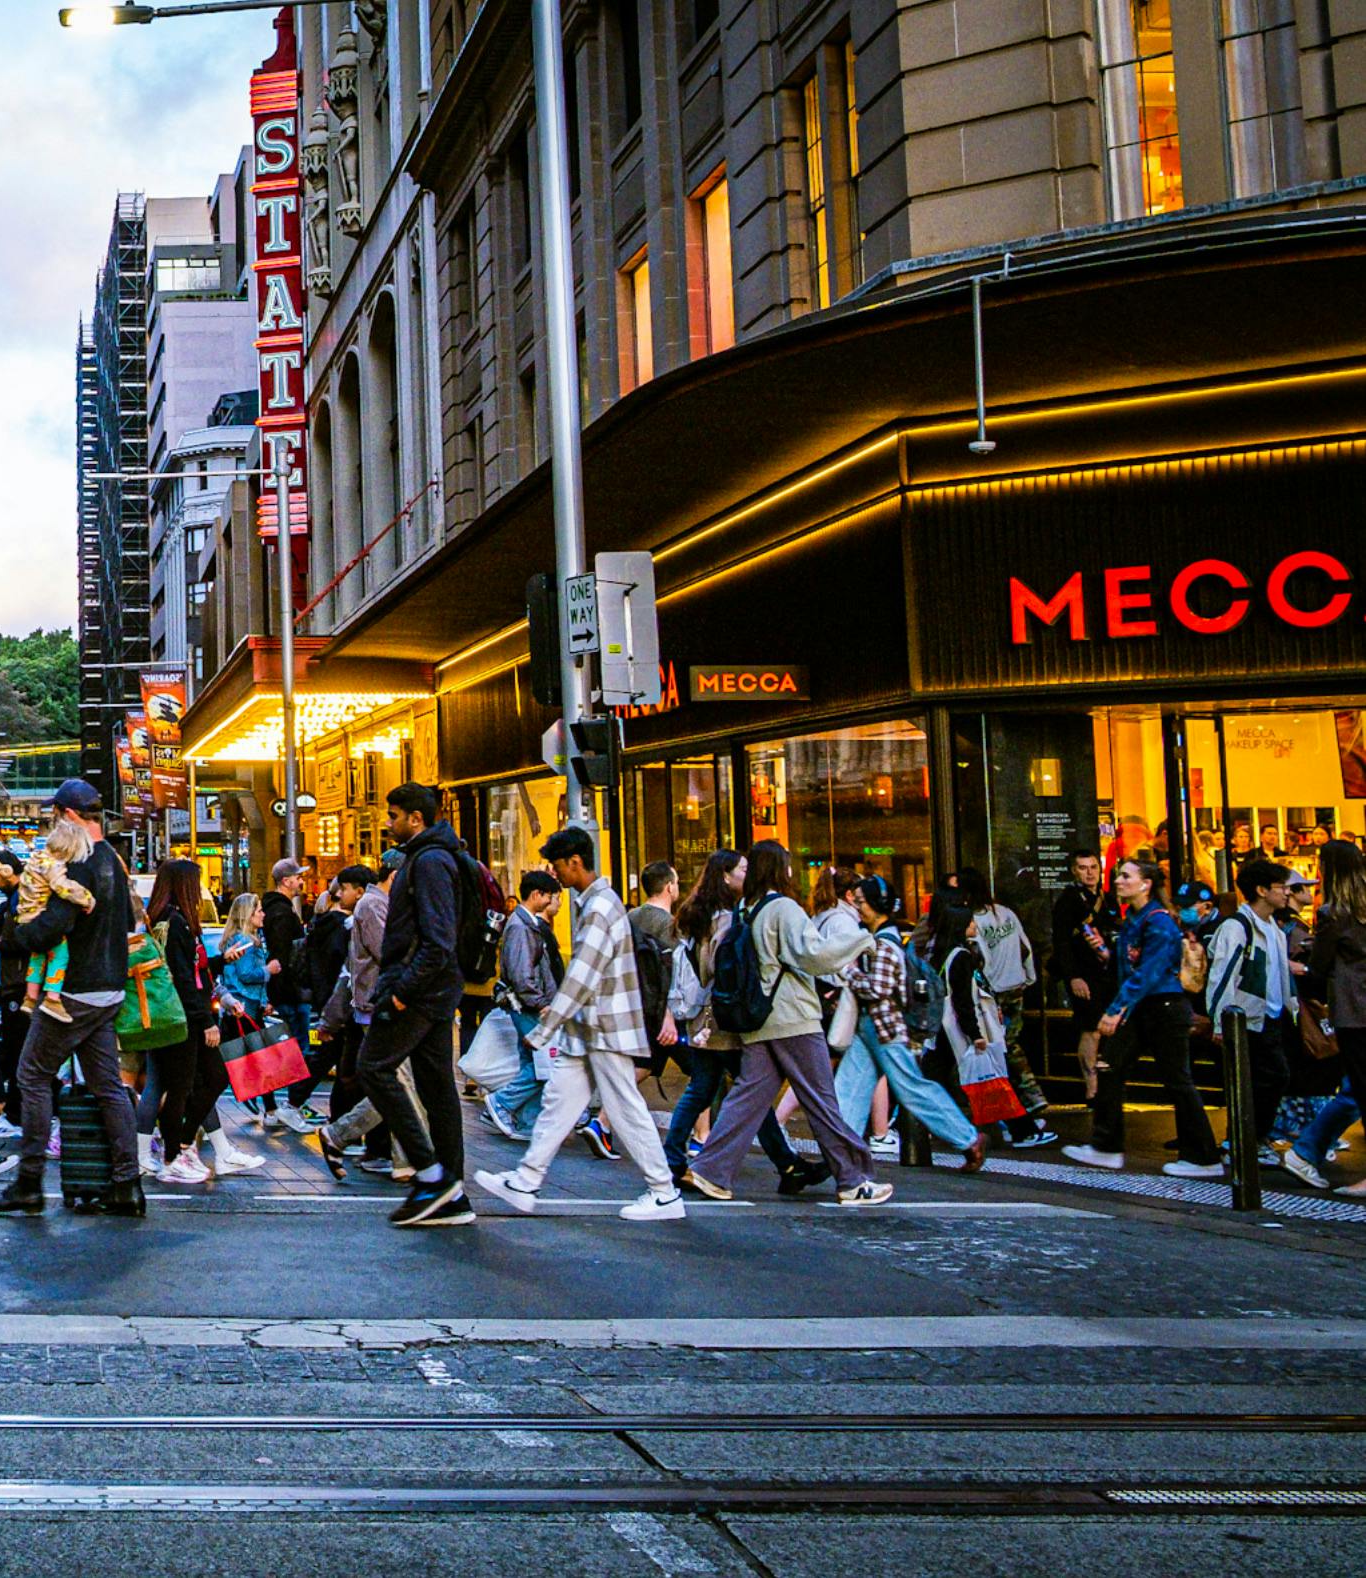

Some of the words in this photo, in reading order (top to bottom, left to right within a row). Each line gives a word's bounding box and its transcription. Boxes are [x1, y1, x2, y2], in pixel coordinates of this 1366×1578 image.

[255, 117, 302, 488] STATE
[570, 582, 591, 602] ONE
[1009, 550, 1366, 644] MECC
[570, 606, 594, 625] WAY
[698, 672, 797, 693] MECCA
[1237, 728, 1275, 738] MECCA
